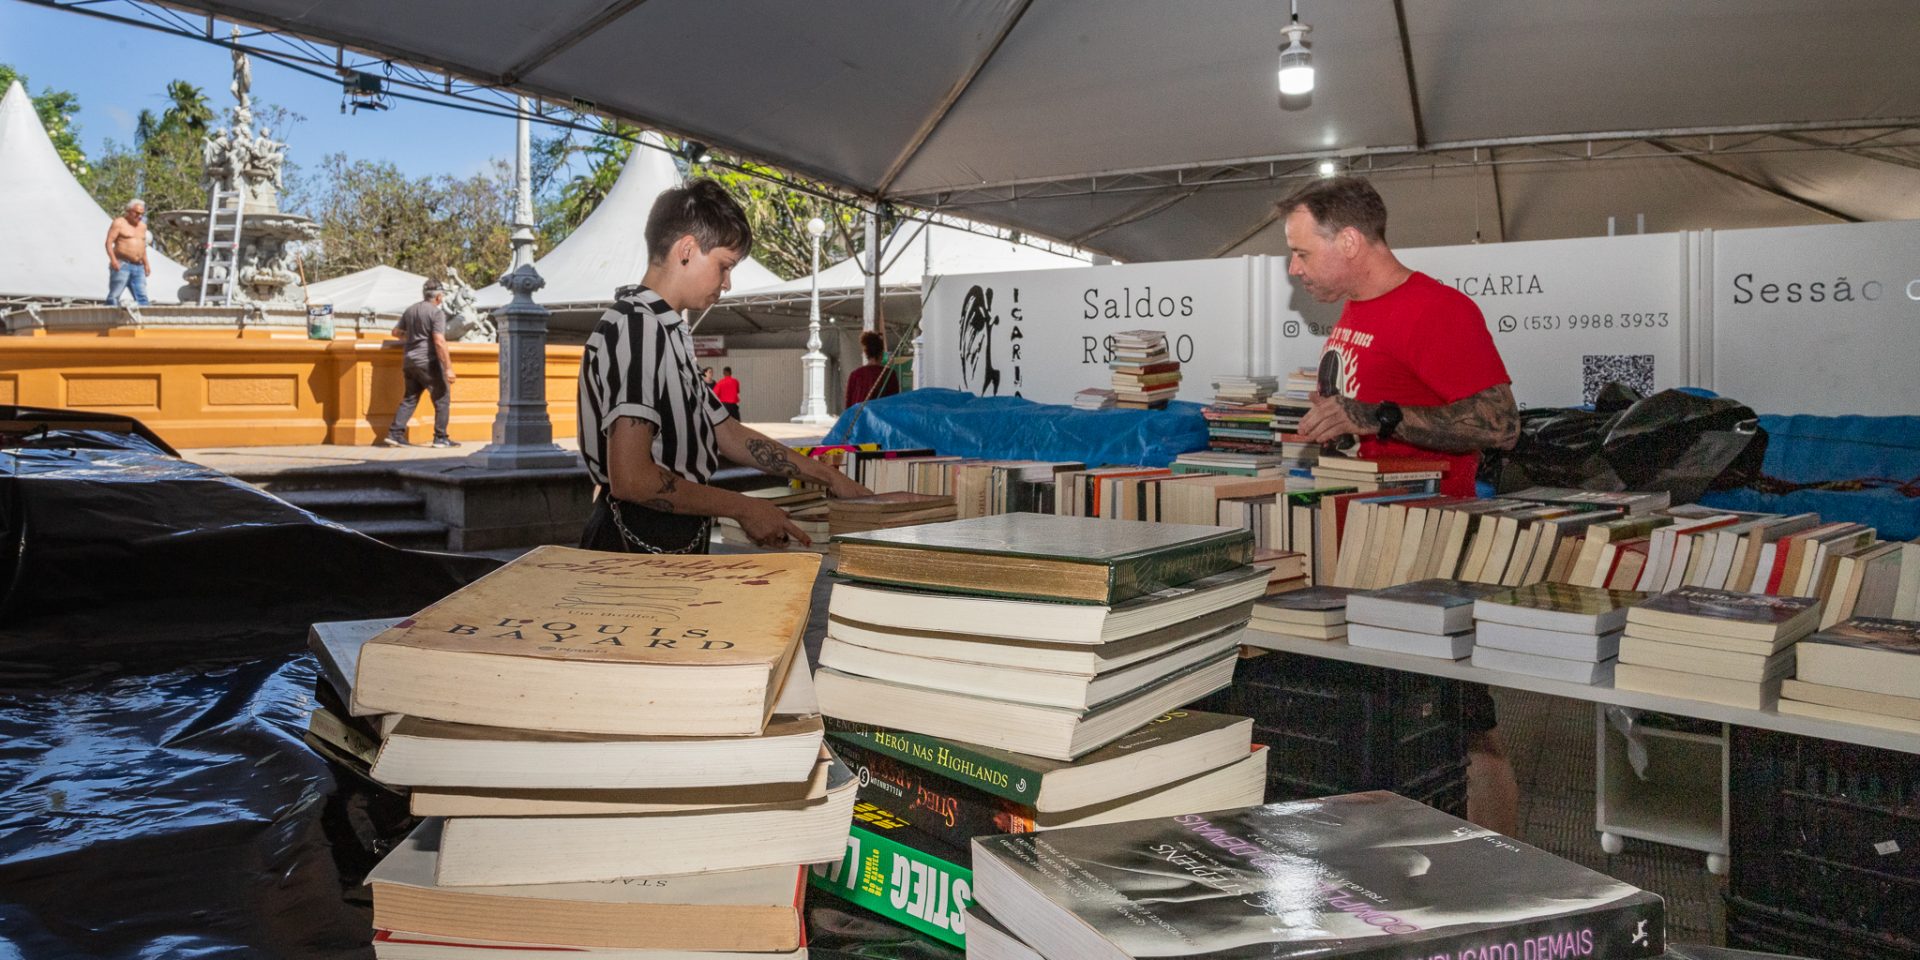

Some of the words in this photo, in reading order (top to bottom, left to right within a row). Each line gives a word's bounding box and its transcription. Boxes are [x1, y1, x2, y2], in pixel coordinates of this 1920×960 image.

[1455, 273, 1544, 296] ICÁRIA
[1733, 273, 1882, 304] Sessão
[1083, 286, 1193, 319] Saldos
[1523, 315, 1561, 330] (53)
[1568, 313, 1614, 329] 9988
[1620, 312, 1669, 328] 3933
[445, 623, 735, 651] BAYARD
[496, 617, 710, 639] LOUIS
[912, 744, 934, 762] NAS
[937, 746, 1009, 789] HIGHLANDS
[890, 852, 972, 935] STIEG
[1523, 929, 1594, 960] DEMAIS
